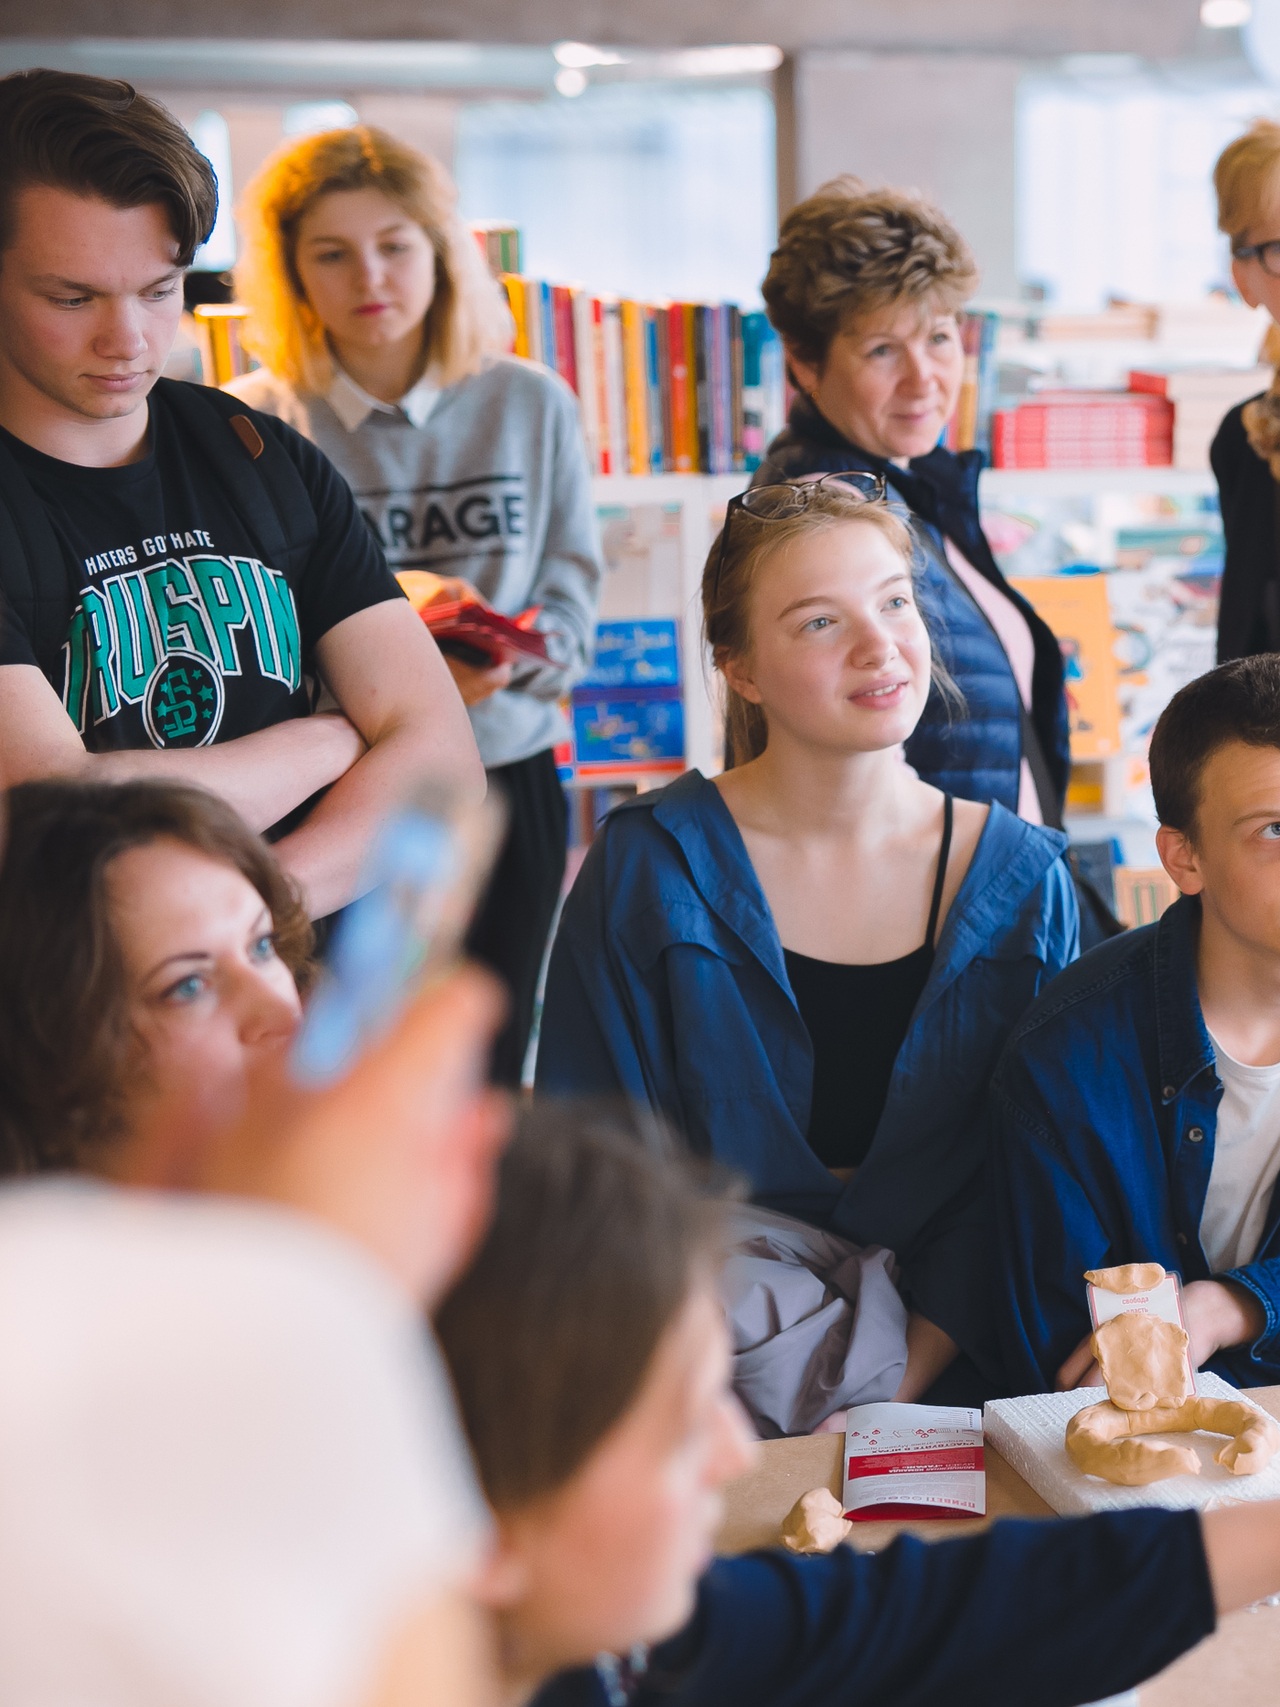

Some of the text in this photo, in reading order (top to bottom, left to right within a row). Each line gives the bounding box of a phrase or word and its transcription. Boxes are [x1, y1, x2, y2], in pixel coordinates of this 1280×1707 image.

[361, 494, 523, 548] RAGE
[85, 546, 138, 576] HATERS
[170, 529, 215, 550] HATE
[61, 555, 301, 735] TRUSPIN
[926, 1497, 976, 1509] ПРИВЕТ!
